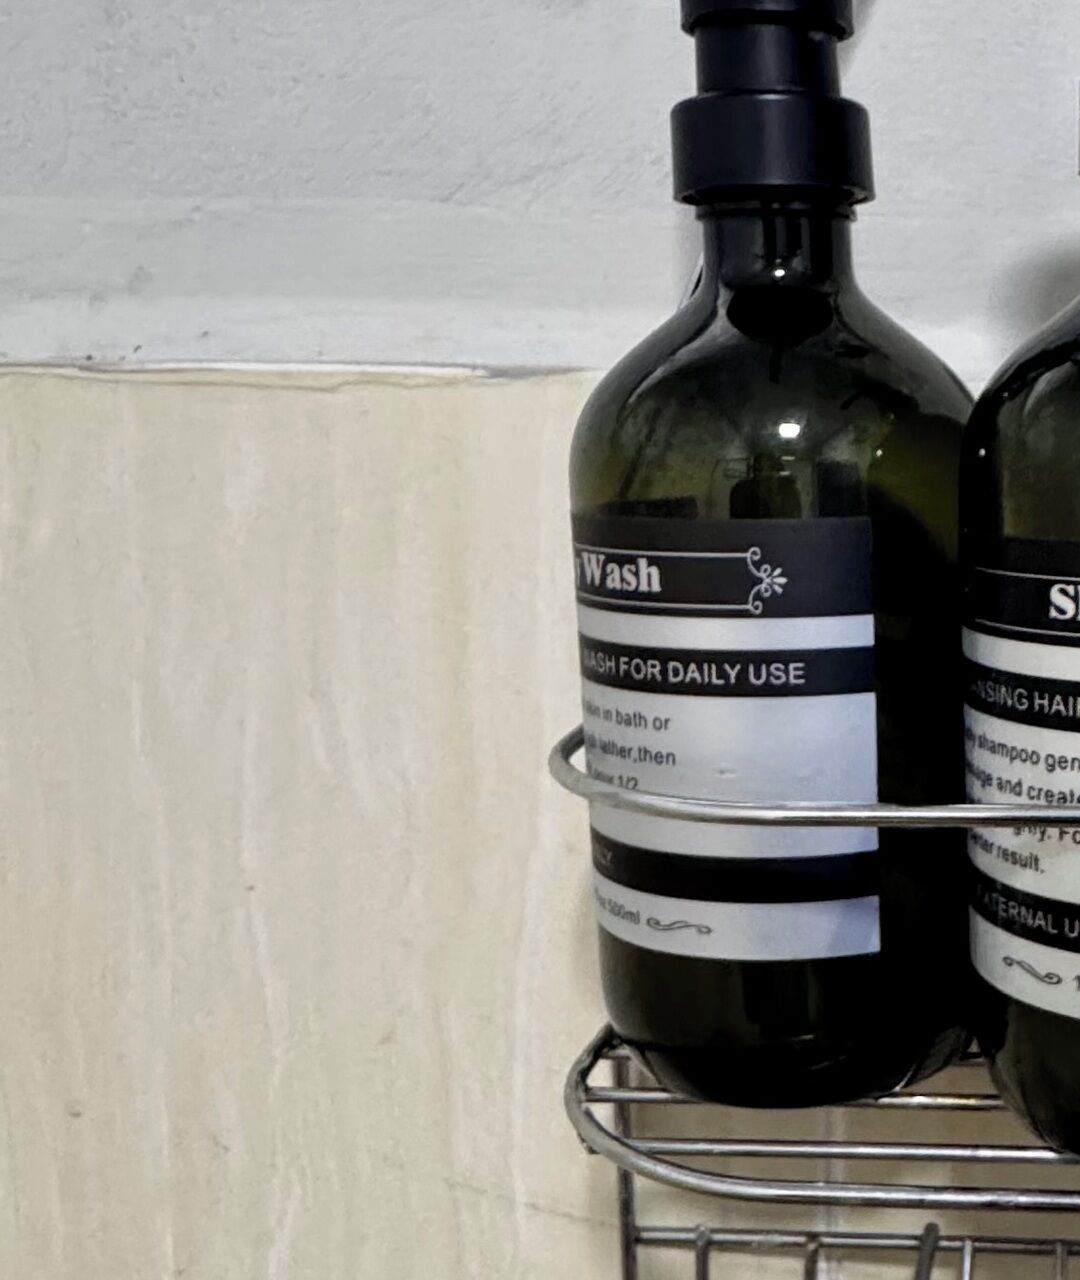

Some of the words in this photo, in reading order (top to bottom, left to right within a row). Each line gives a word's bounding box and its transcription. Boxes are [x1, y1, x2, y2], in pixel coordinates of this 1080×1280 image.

[580, 551, 662, 593] Wash
[620, 657, 662, 683] FOR
[667, 660, 741, 686] DAILY
[749, 662, 806, 686] USE
[616, 707, 648, 730] bath
[653, 716, 671, 731] or
[977, 730, 1041, 765] shampoo
[996, 776, 1023, 798] and
[997, 843, 1045, 874] result.
